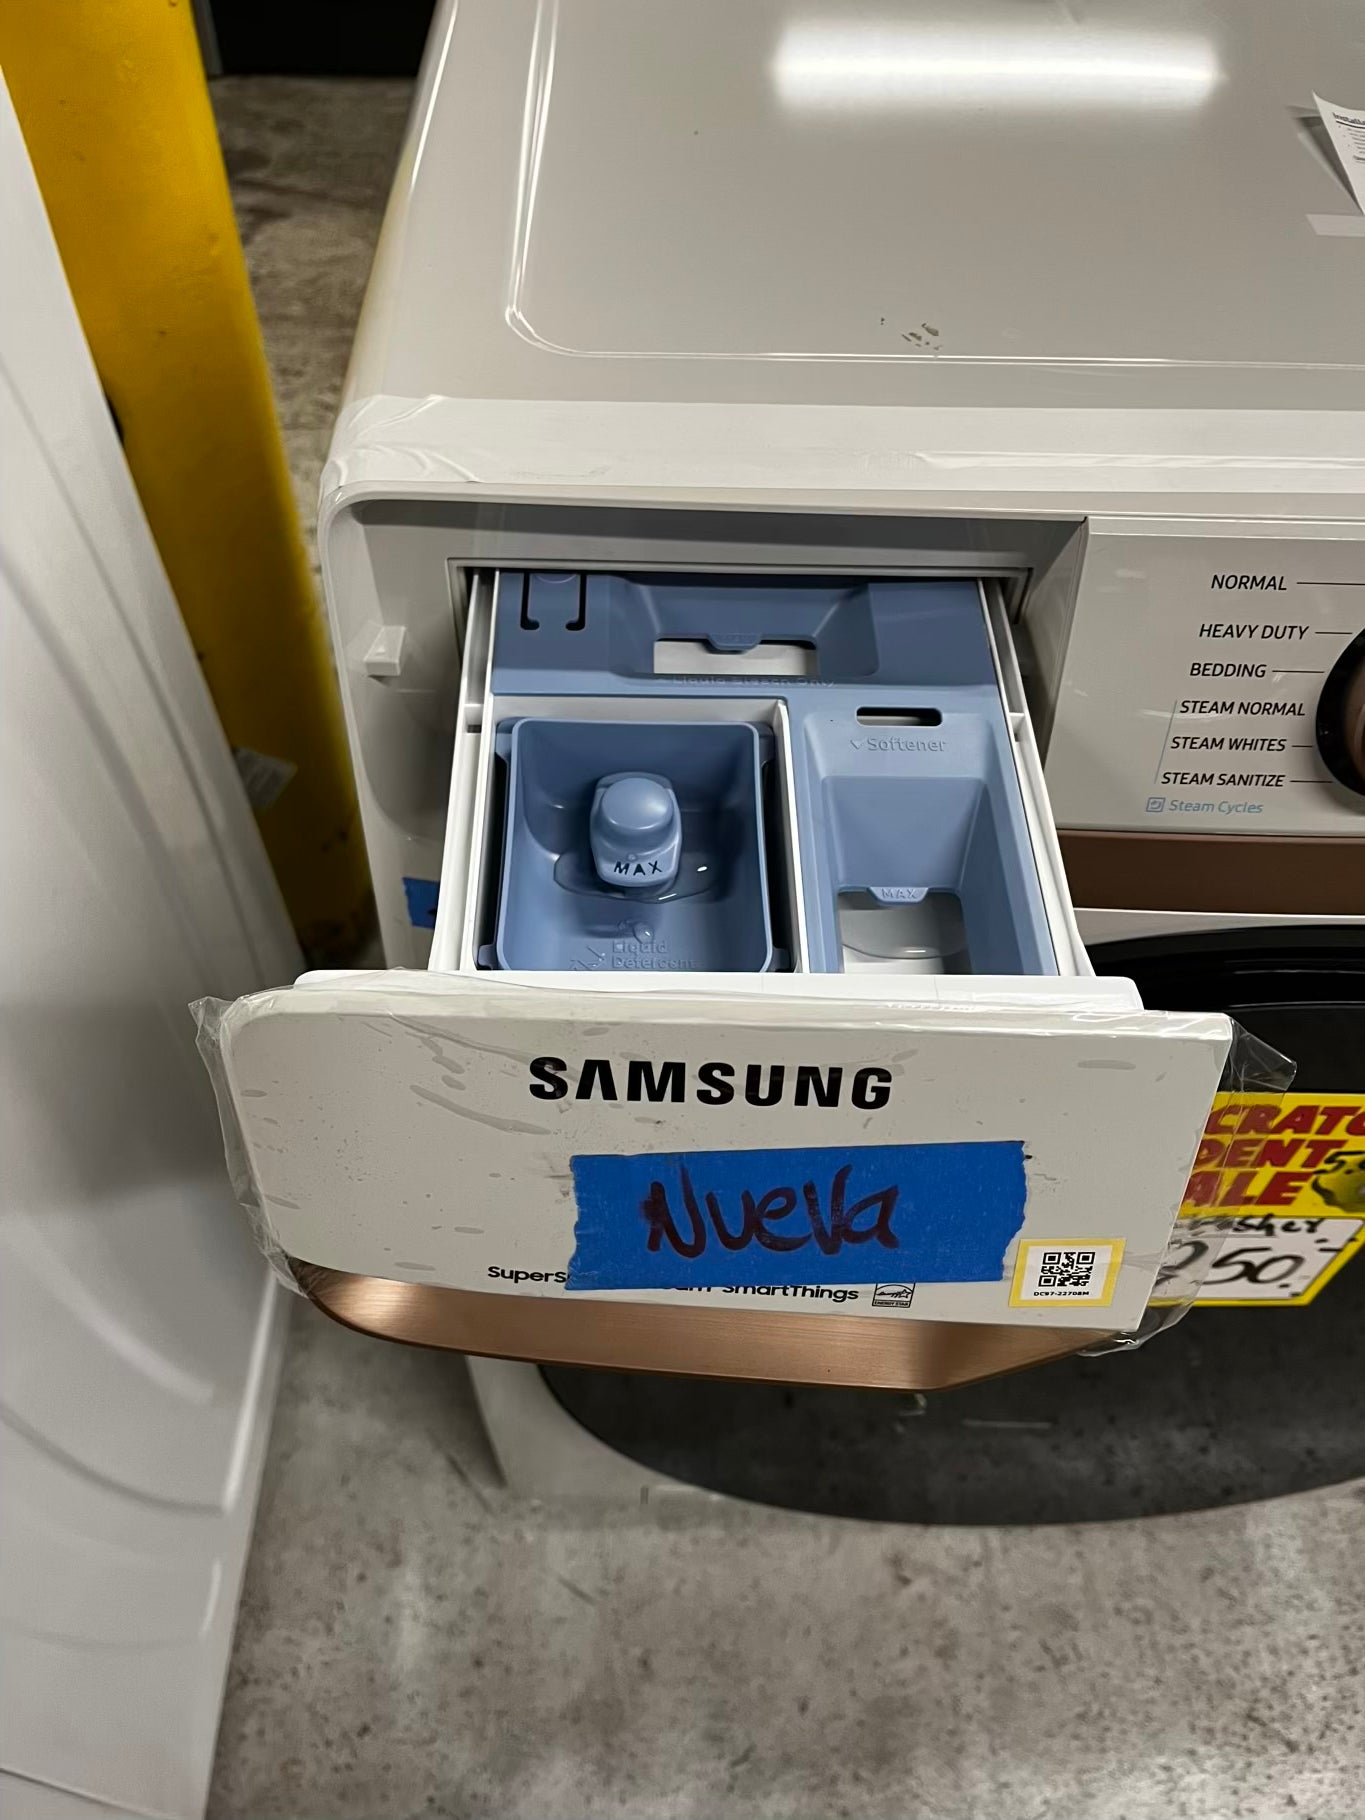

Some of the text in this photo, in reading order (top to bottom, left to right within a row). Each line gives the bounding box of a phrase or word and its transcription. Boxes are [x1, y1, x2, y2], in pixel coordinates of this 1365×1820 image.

[1211, 574, 1288, 591] NORMAL
[1199, 623, 1309, 640] HEAVY DUTY
[1189, 662, 1267, 678] BEDDING
[1180, 700, 1306, 717] STEAM NORMAL
[866, 736, 947, 752] Softener
[1170, 736, 1287, 752] STEAM WHITES
[1161, 772, 1286, 788] STEAM SANITIZE
[1169, 799, 1264, 816] Steam Cycles
[613, 859, 664, 876] MAX
[881, 887, 917, 899] MAX
[529, 1056, 893, 1110] SAMSUNG
[1193, 1139, 1348, 1169] DENT
[487, 1265, 570, 1284] SuperS
